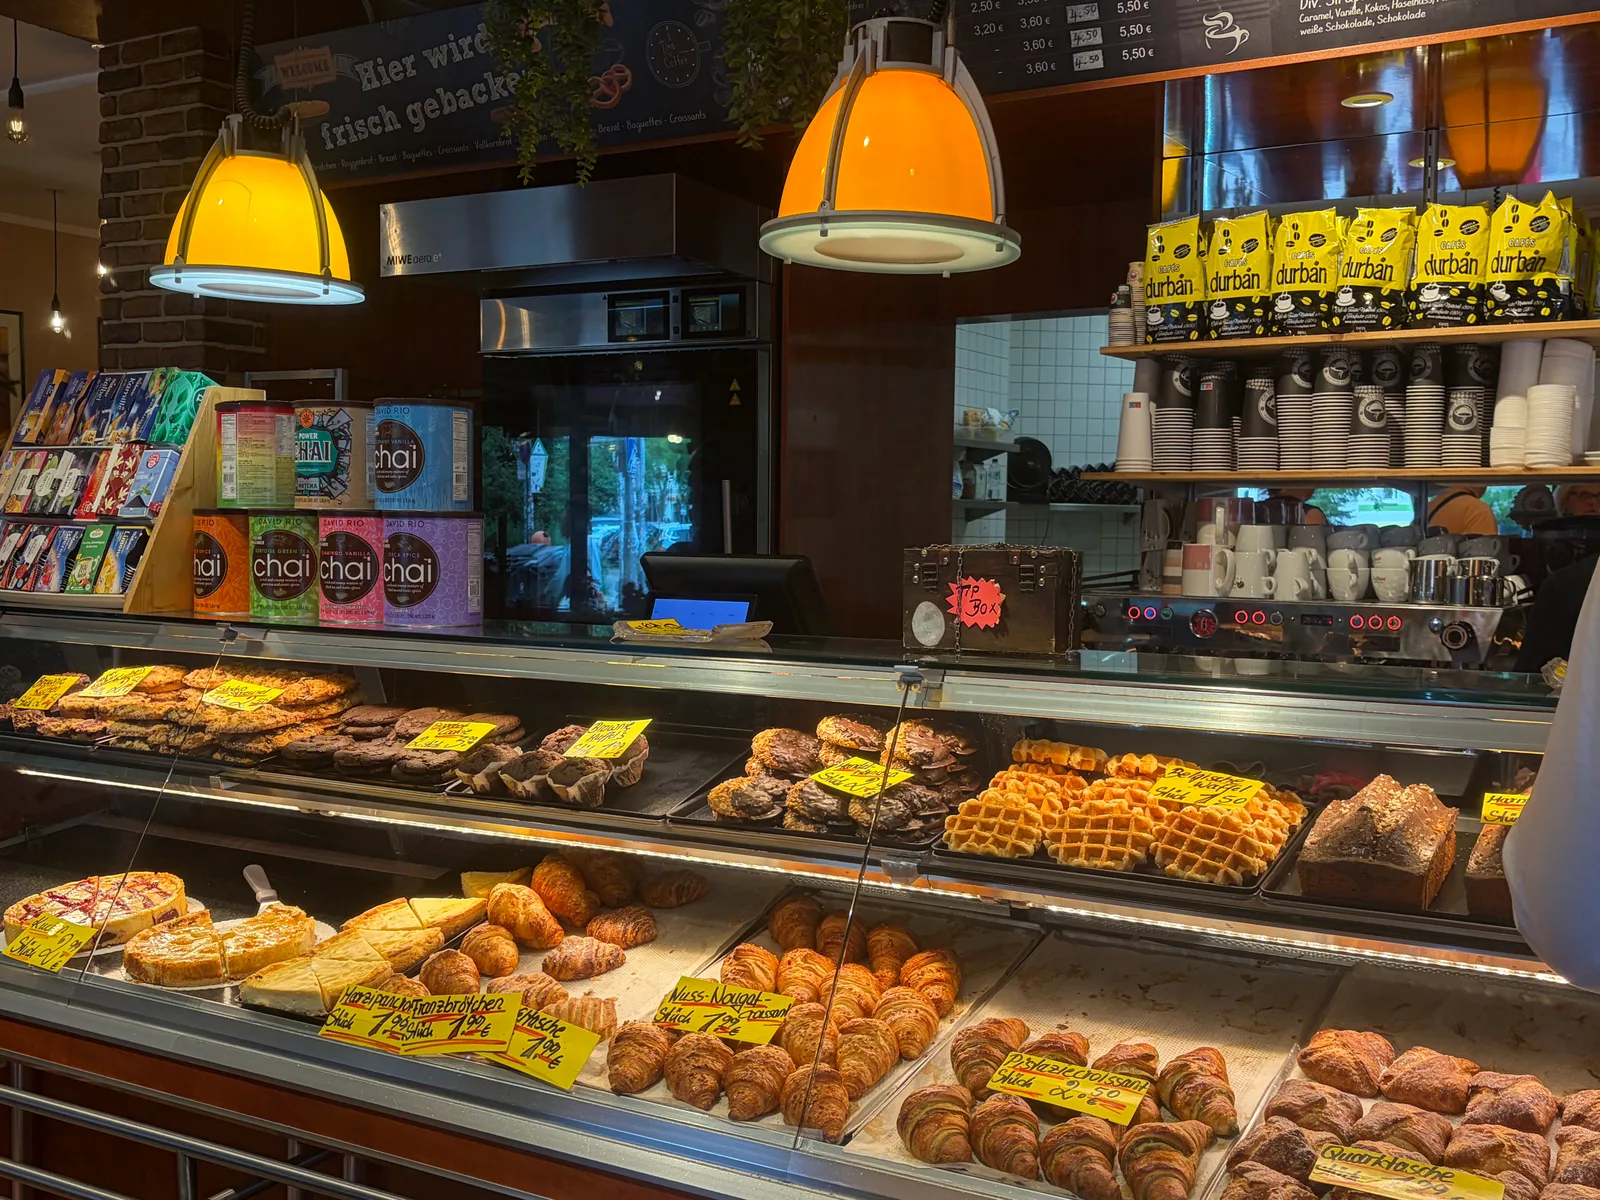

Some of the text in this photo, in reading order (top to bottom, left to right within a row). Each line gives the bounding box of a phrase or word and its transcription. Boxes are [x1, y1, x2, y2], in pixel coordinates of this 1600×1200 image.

[971, 1, 993, 13] 2,50
[1117, 0, 1141, 13] 5,50
[1299, 10, 1334, 23] Caramel,
[1335, 6, 1364, 18] Vanille,
[1364, 2, 1391, 15] Kokos,
[974, 23, 996, 36] 3,20
[1020, 15, 1042, 29] 3,60
[1120, 24, 1143, 37] 5,50
[1299, 9, 1427, 35] weiße Schokolade, Schokolade
[1023, 38, 1046, 52] 3,60
[1122, 47, 1146, 61] 5,50
[354, 22, 494, 92] Hier wird
[280, 59, 330, 78] WELCOME
[1026, 61, 1048, 74] 3,60
[321, 71, 526, 150] frisch gebacke
[597, 110, 707, 134] Brezel Baguettes Croissants
[402, 146, 433, 162] Baguettes
[437, 142, 470, 155] Croissants
[387, 254, 412, 266] MIWE
[413, 254, 431, 264] aero
[258, 518, 303, 526] DAVID RIO
[323, 519, 364, 527] DAVID RIO
[407, 520, 425, 528] RIO
[960, 584, 980, 599] TIP
[964, 599, 999, 617] BOX
[1163, 767, 1246, 784] Belgische
[1155, 785, 1191, 801] Stück
[31, 915, 69, 934] Kucn
[10, 935, 42, 959] Stück
[411, 995, 505, 1017] Franzbrötchen
[654, 1006, 694, 1024] Stück
[324, 1008, 357, 1031] Stück
[401, 1020, 434, 1042] Stück
[990, 1068, 1036, 1089] Stück
[1320, 1145, 1457, 1184] Quarktasche
